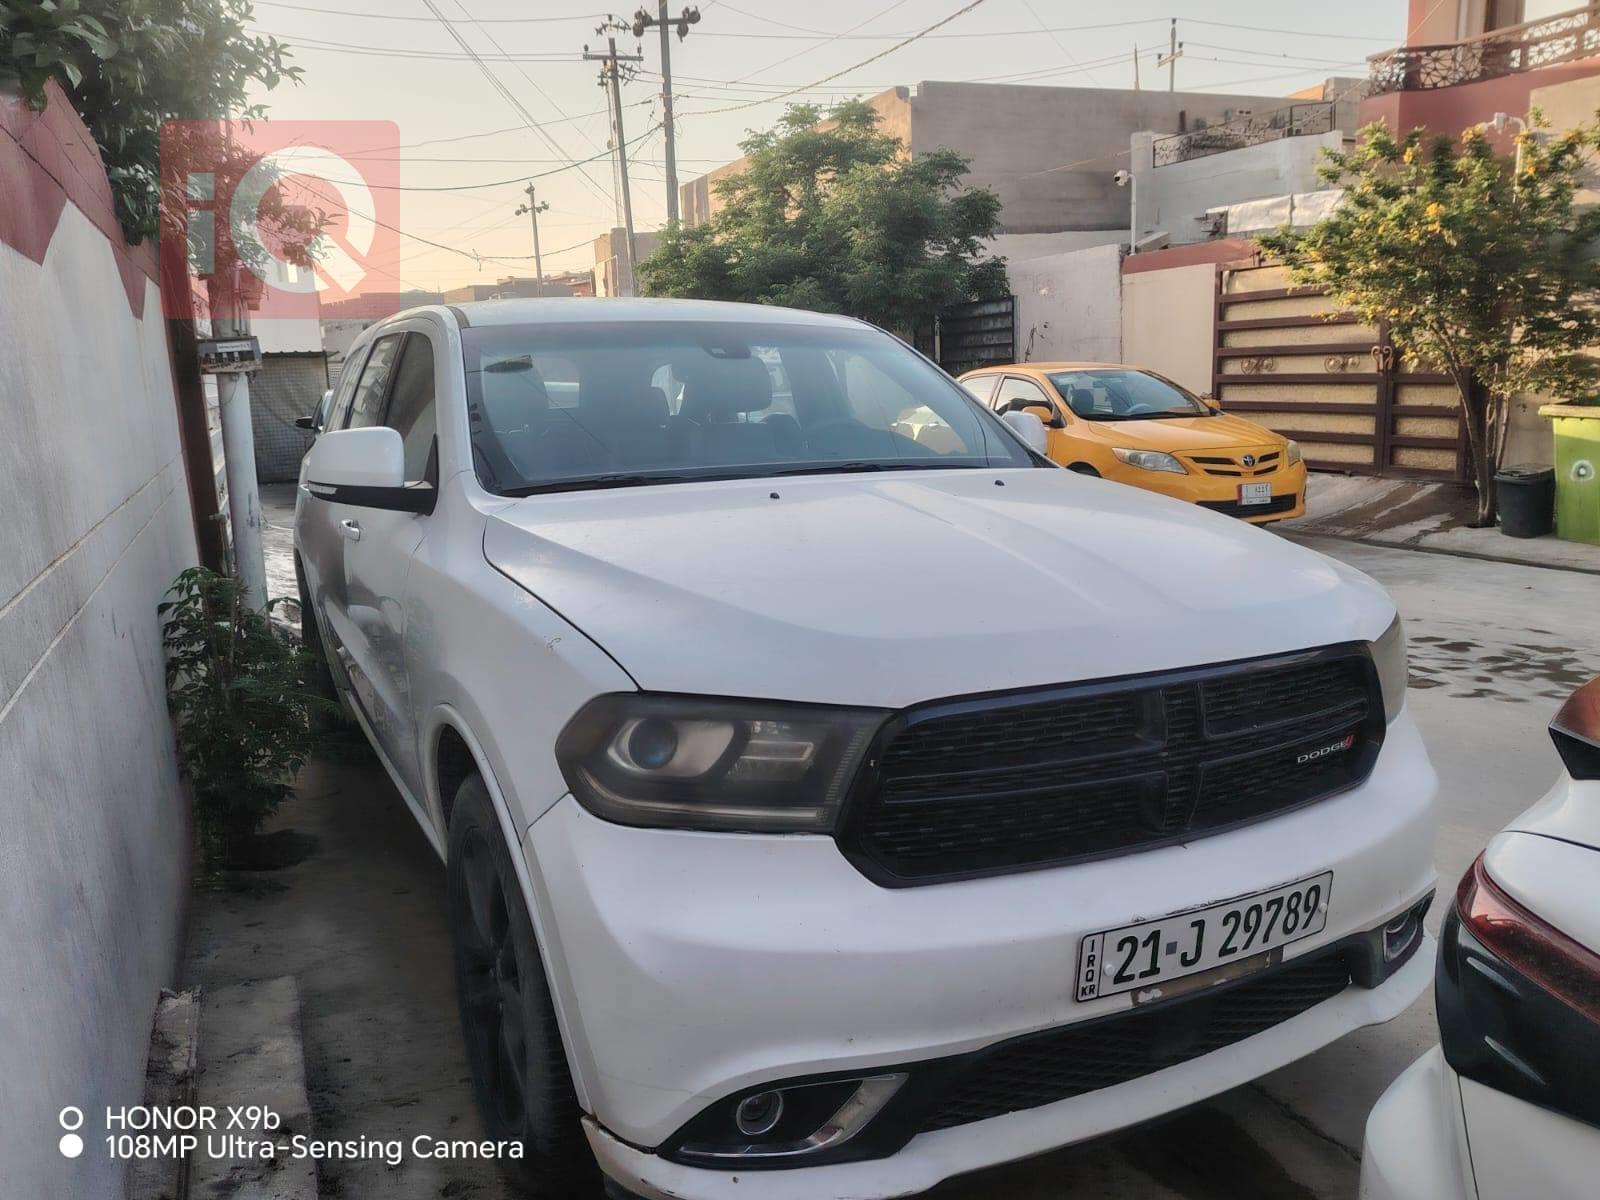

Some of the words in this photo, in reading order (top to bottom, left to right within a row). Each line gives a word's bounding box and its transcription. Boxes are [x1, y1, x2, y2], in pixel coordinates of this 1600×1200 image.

[1297, 741, 1346, 763] DODGE
[1113, 929, 1161, 985] 21
[1180, 919, 1205, 967] J
[1218, 884, 1321, 958] 29789
